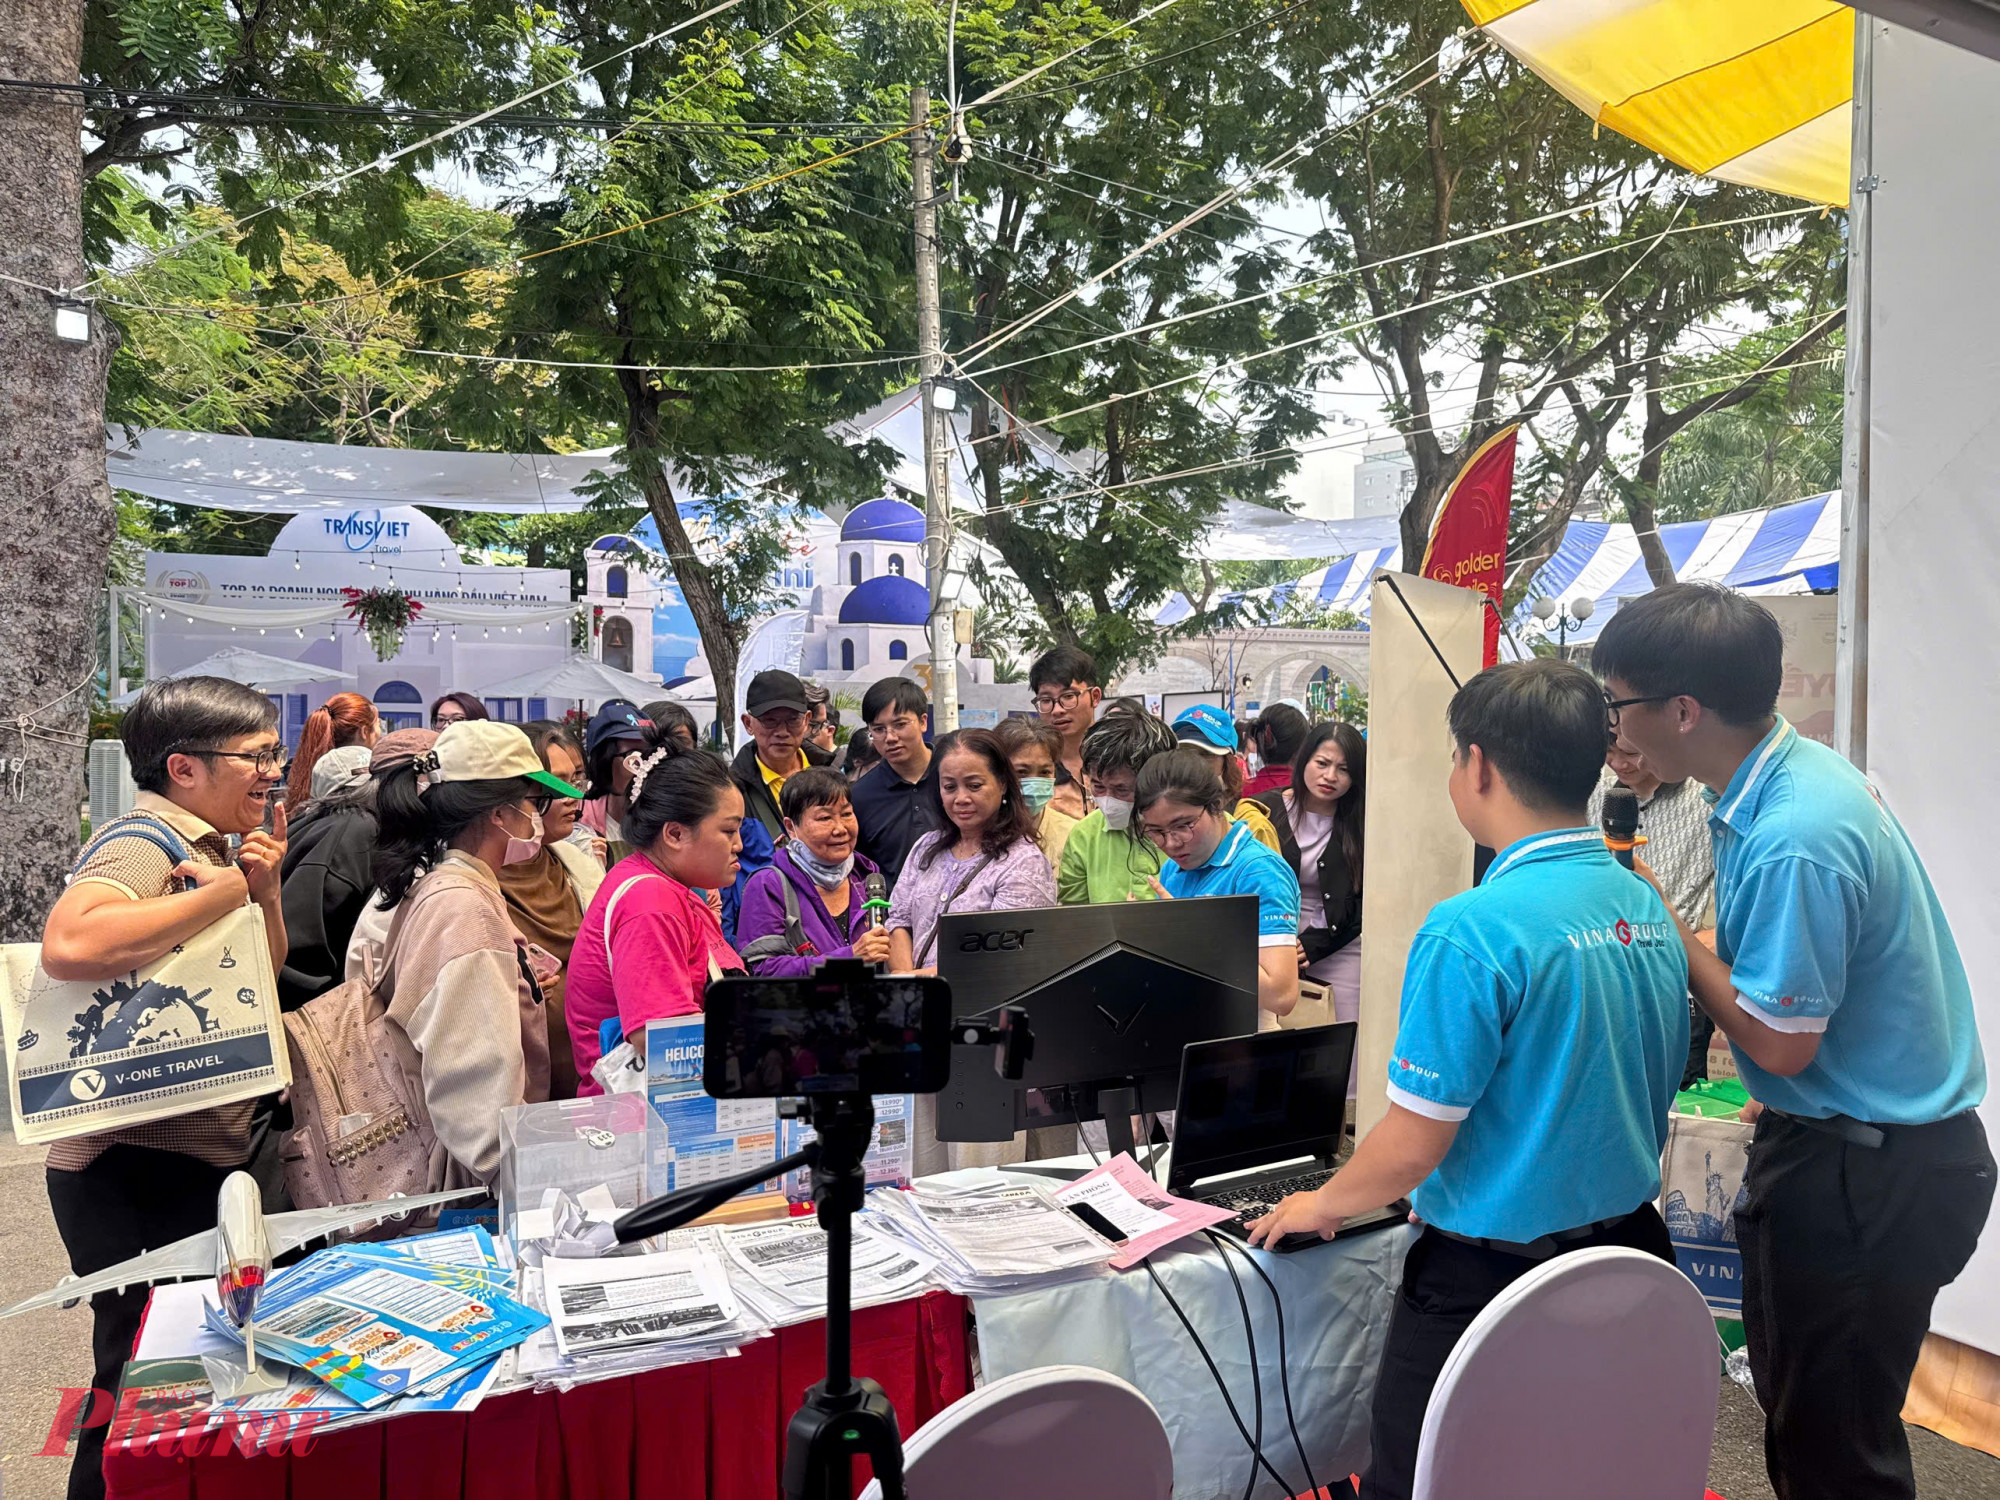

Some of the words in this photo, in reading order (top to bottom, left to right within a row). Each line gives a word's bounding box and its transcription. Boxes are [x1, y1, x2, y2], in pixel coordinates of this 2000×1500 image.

[324, 515, 410, 542] TRANSVIET
[375, 545, 402, 554] Travel
[960, 928, 1035, 953] acer
[1567, 918, 1668, 949] VINAGROUP
[115, 1067, 161, 1084] V-ONE
[164, 1054, 224, 1075] TRAVEL
[1691, 1262, 1742, 1282] VIN
